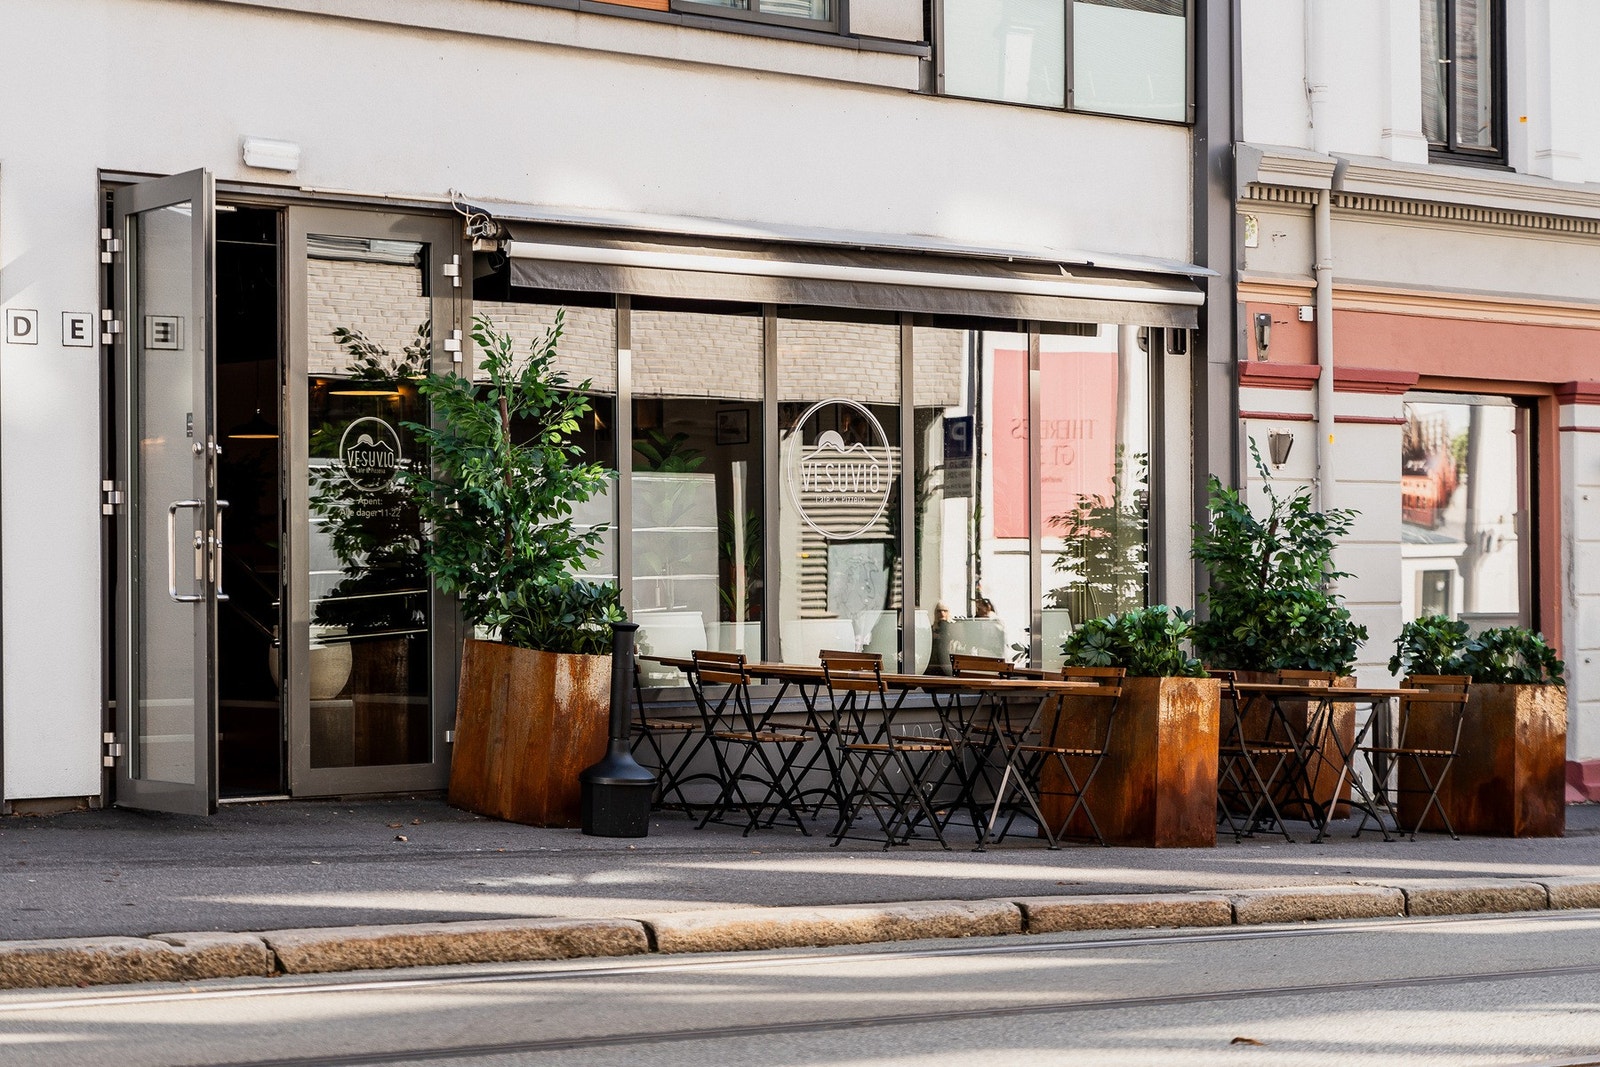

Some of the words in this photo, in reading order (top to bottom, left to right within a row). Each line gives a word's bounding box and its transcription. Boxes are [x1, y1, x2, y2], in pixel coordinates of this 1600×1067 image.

[13, 316, 31, 337] D
[71, 318, 84, 339] E
[347, 450, 395, 468] VESUVIO
[801, 463, 880, 493] VESUVIO
[356, 507, 378, 519] dager
[380, 509, 401, 518] 11-22
